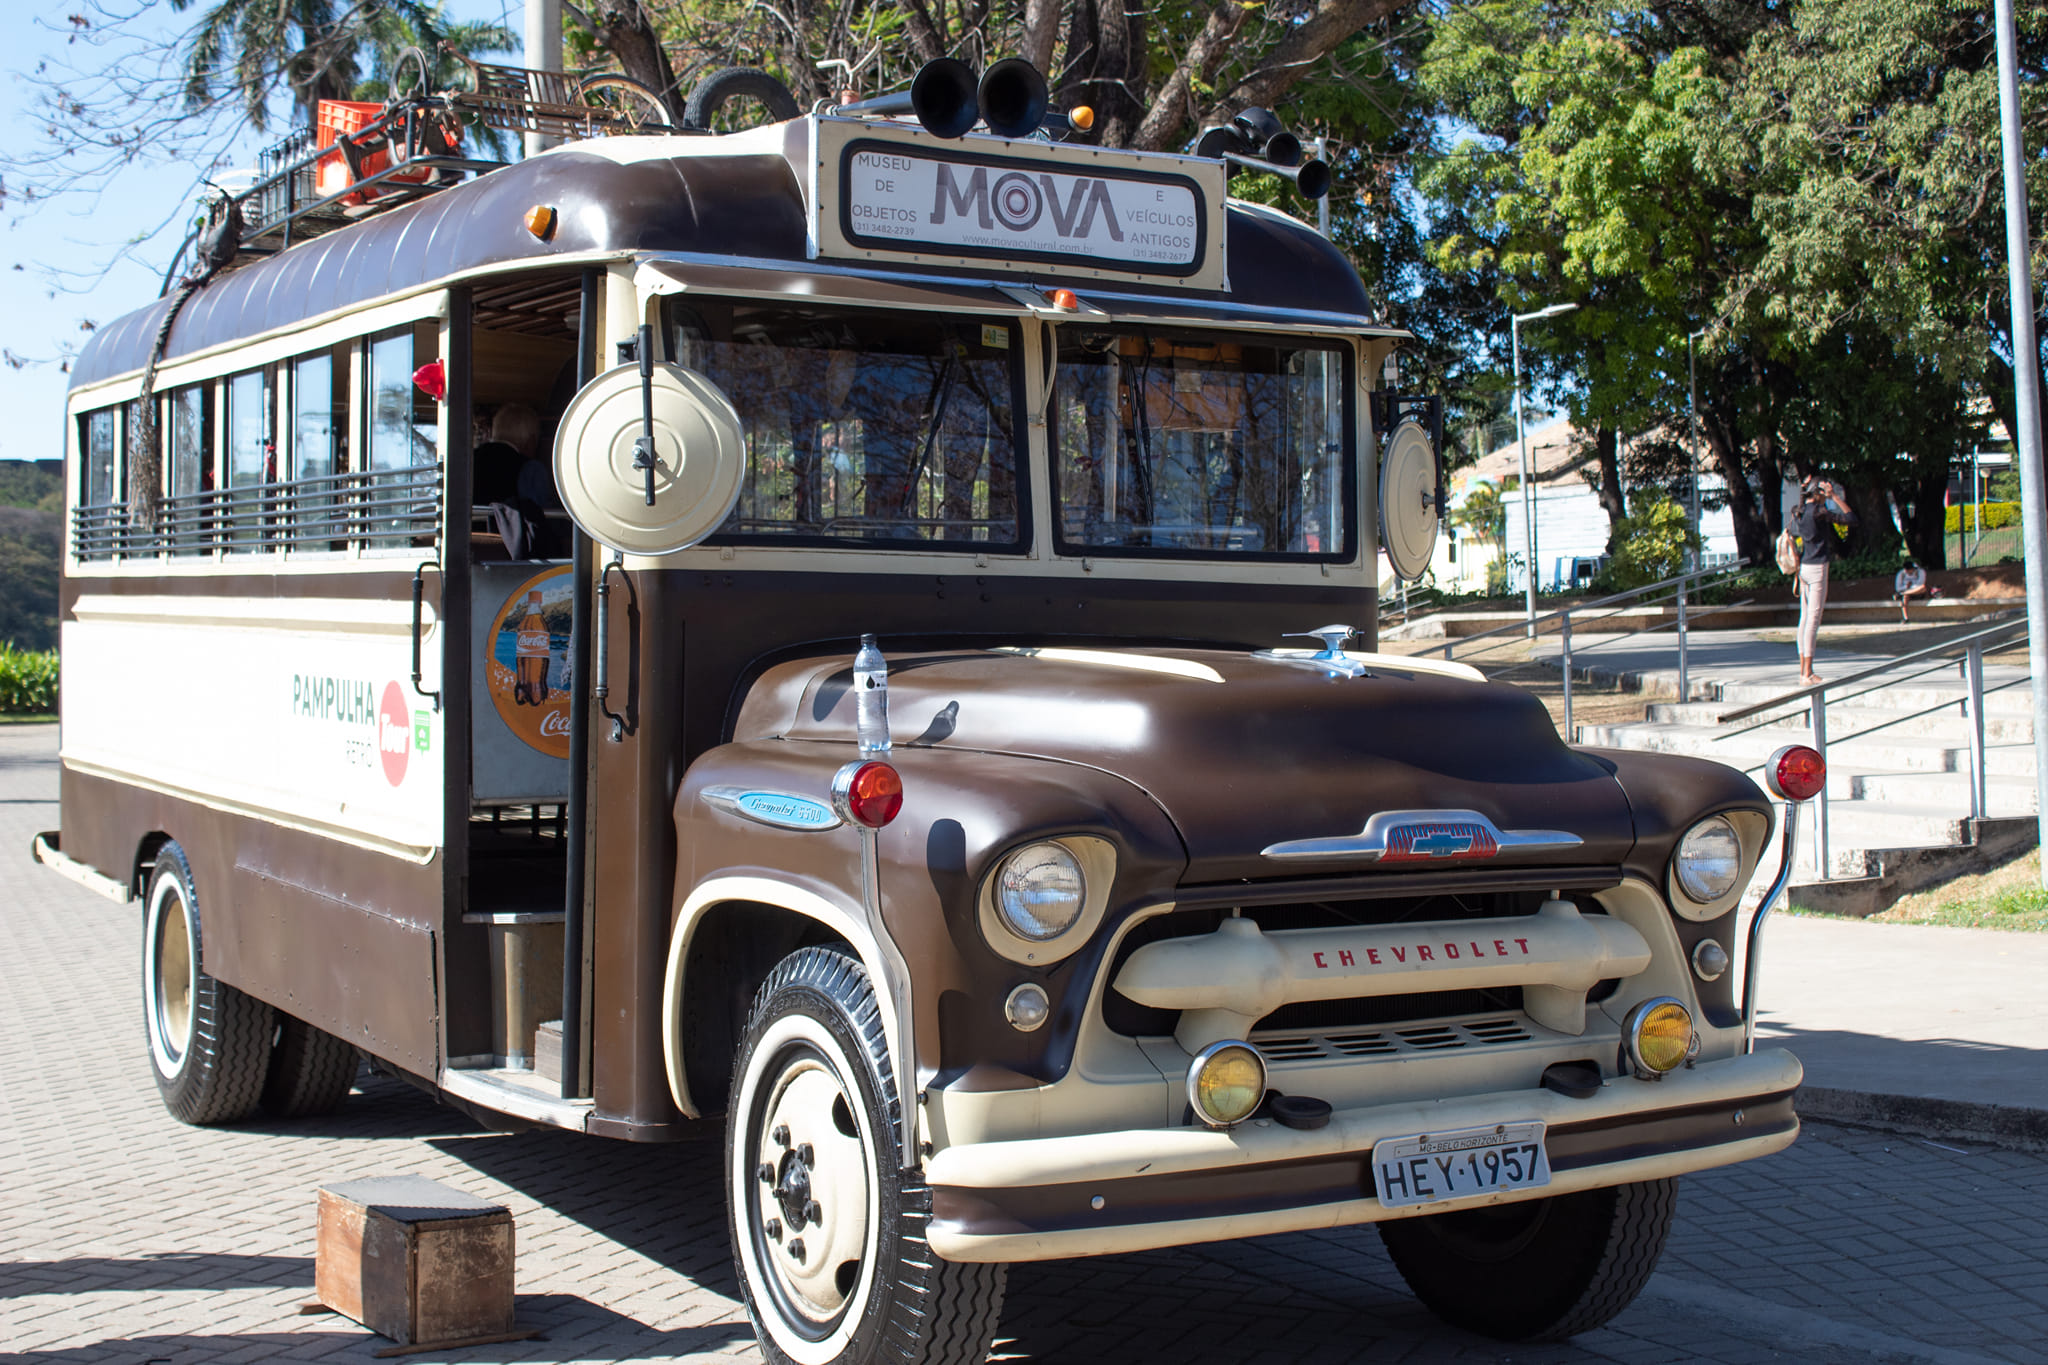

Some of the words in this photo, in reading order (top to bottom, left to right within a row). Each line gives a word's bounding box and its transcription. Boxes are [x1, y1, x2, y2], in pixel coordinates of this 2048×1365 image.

[858, 154, 911, 171] MUSEU
[875, 179, 895, 193] DE
[930, 163, 1123, 242] MOVA
[1156, 190, 1164, 202] E
[852, 204, 918, 222] OBJETOS
[1126, 209, 1194, 228] VEÍCULOS
[853, 221, 869, 232] (31)
[871, 224, 915, 236] 3482-2739
[962, 234, 1095, 254] www.movacultural.com.br
[1130, 232, 1190, 249] ANTIGOS
[1133, 248, 1147, 258] (31)
[294, 673, 376, 726] PAMPULHA
[1313, 938, 1529, 968] CHEVROLET
[1460, 1134, 1509, 1148] HORIZONTE
